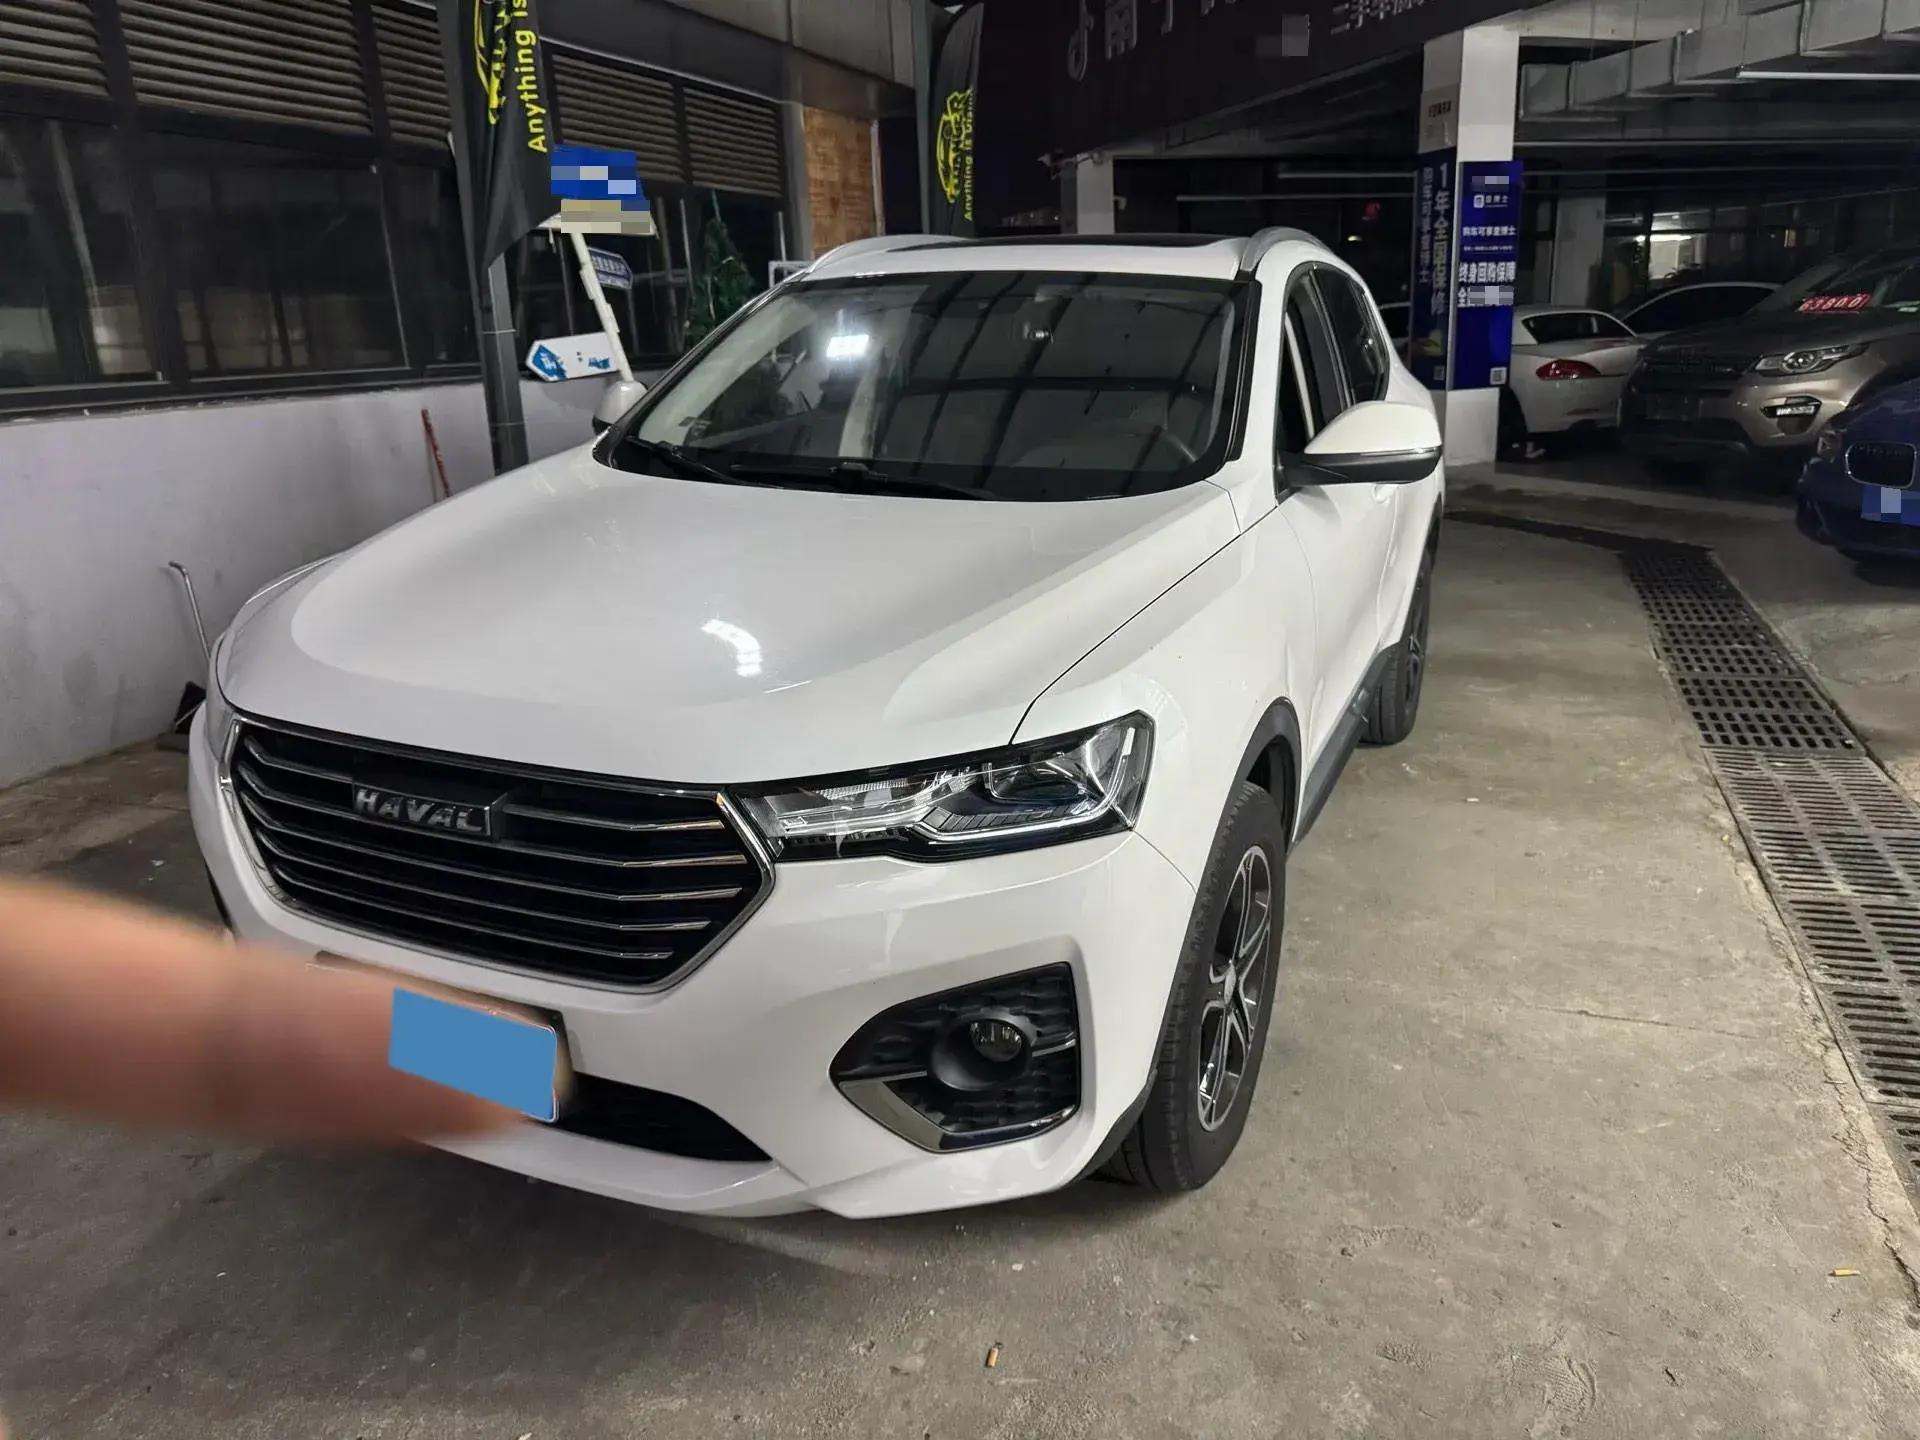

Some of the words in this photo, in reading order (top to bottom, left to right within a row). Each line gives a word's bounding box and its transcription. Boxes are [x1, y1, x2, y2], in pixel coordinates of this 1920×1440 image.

[513, 30, 549, 153] Anything
[964, 156, 973, 221] Anything
[1458, 261, 1516, 283] 终身回购保障
[355, 788, 482, 832] HAVAL
